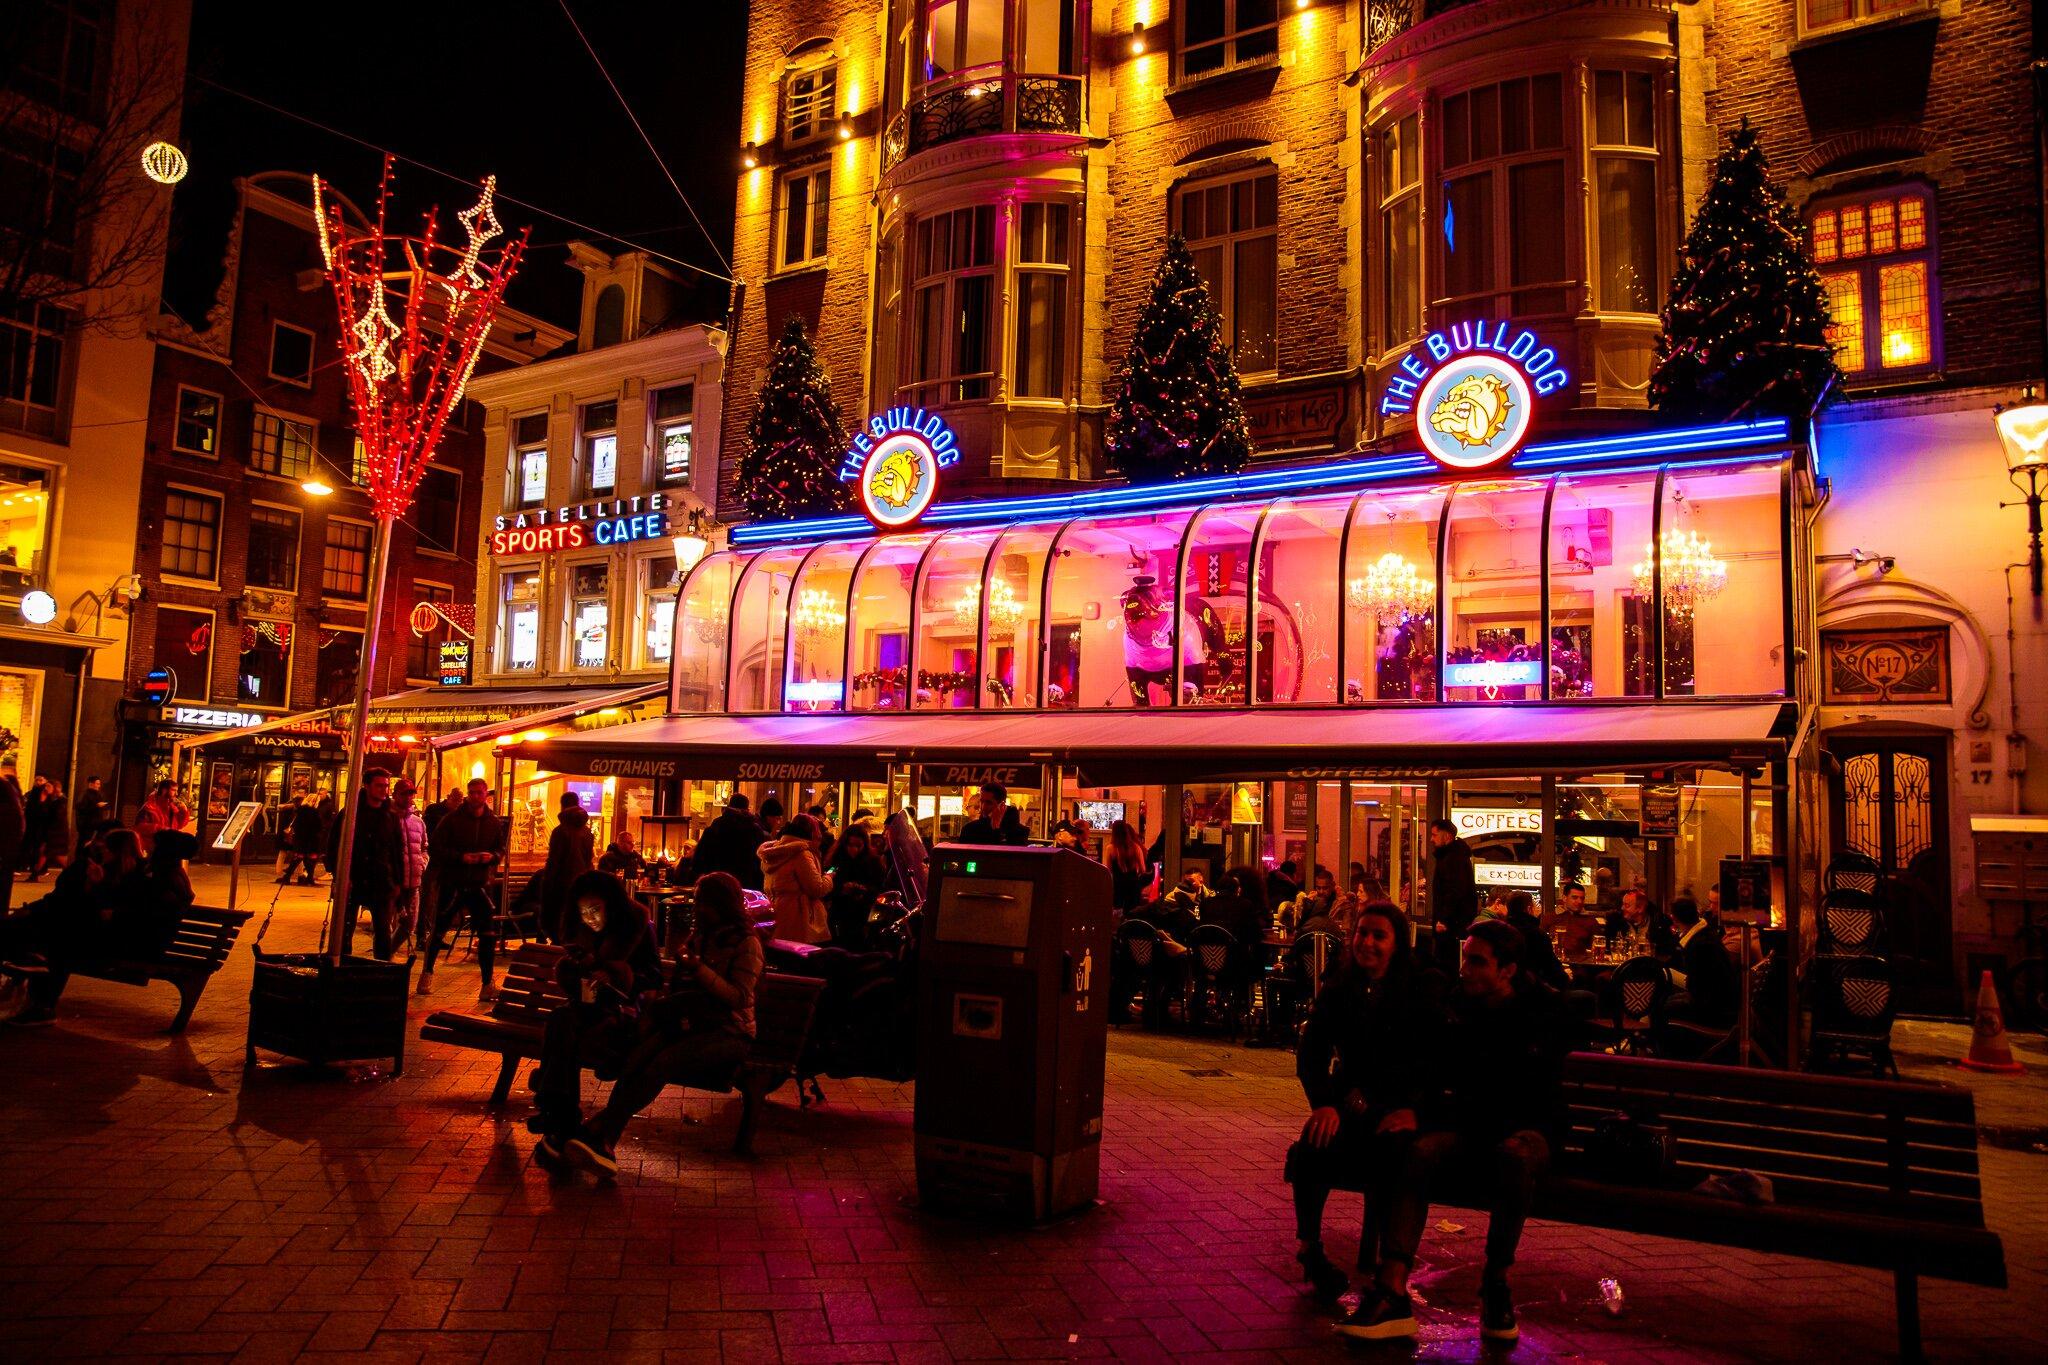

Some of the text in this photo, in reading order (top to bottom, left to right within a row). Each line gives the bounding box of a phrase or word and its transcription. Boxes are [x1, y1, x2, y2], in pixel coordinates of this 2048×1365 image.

[1381, 319, 1567, 414] THE BULLDOG
[839, 406, 960, 481] THE BULLDOG
[495, 493, 662, 531] SATELLITE
[494, 514, 661, 554] SPORTS CAFE
[440, 669, 466, 677] SPORTS
[443, 676, 462, 685] CAFE
[161, 707, 263, 728] PIZZERIA
[254, 736, 321, 749] MAXIMUS
[589, 758, 676, 777] GOTTAHAVES
[737, 763, 825, 779] SOUVENIRS
[945, 766, 1019, 784] PALACE
[1970, 769, 1992, 785] 17
[1461, 813, 1541, 830] COFFEES
